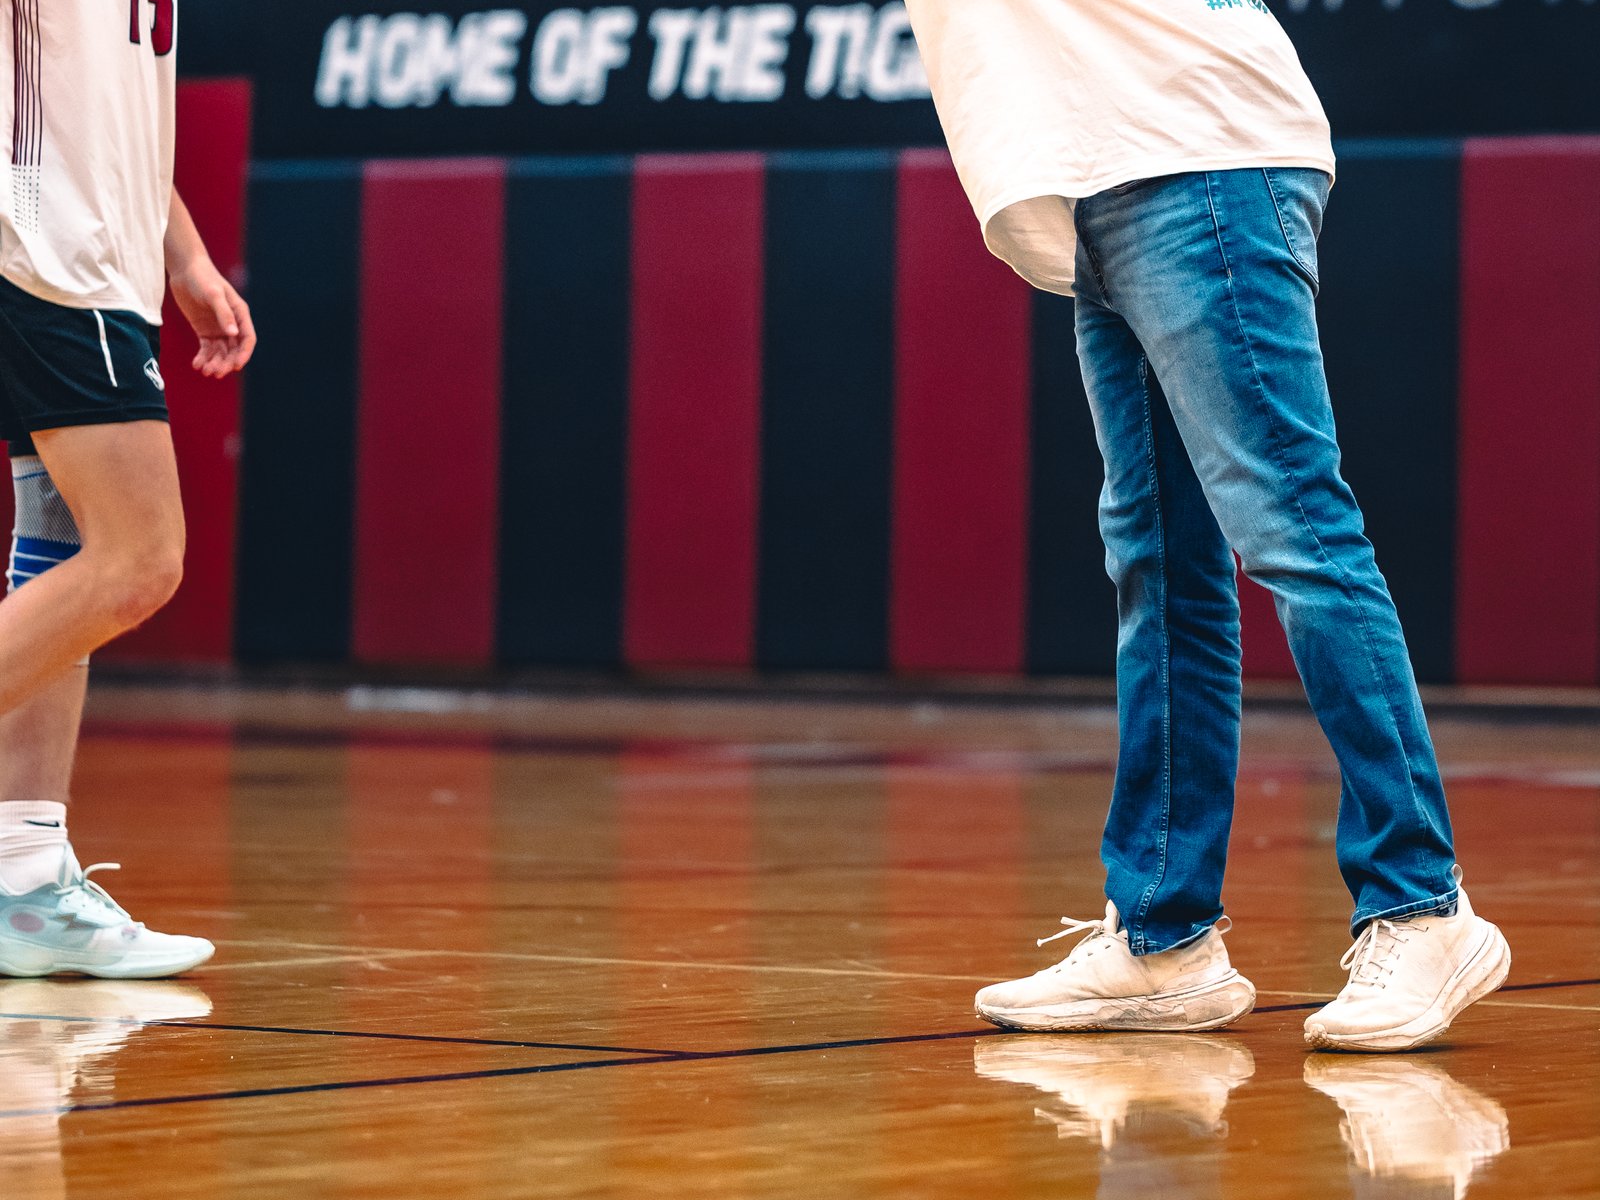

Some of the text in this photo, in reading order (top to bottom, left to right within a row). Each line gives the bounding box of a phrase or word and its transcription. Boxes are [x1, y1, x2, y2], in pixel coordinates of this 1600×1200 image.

[314, 0, 933, 108] HOME OF THE TIG
